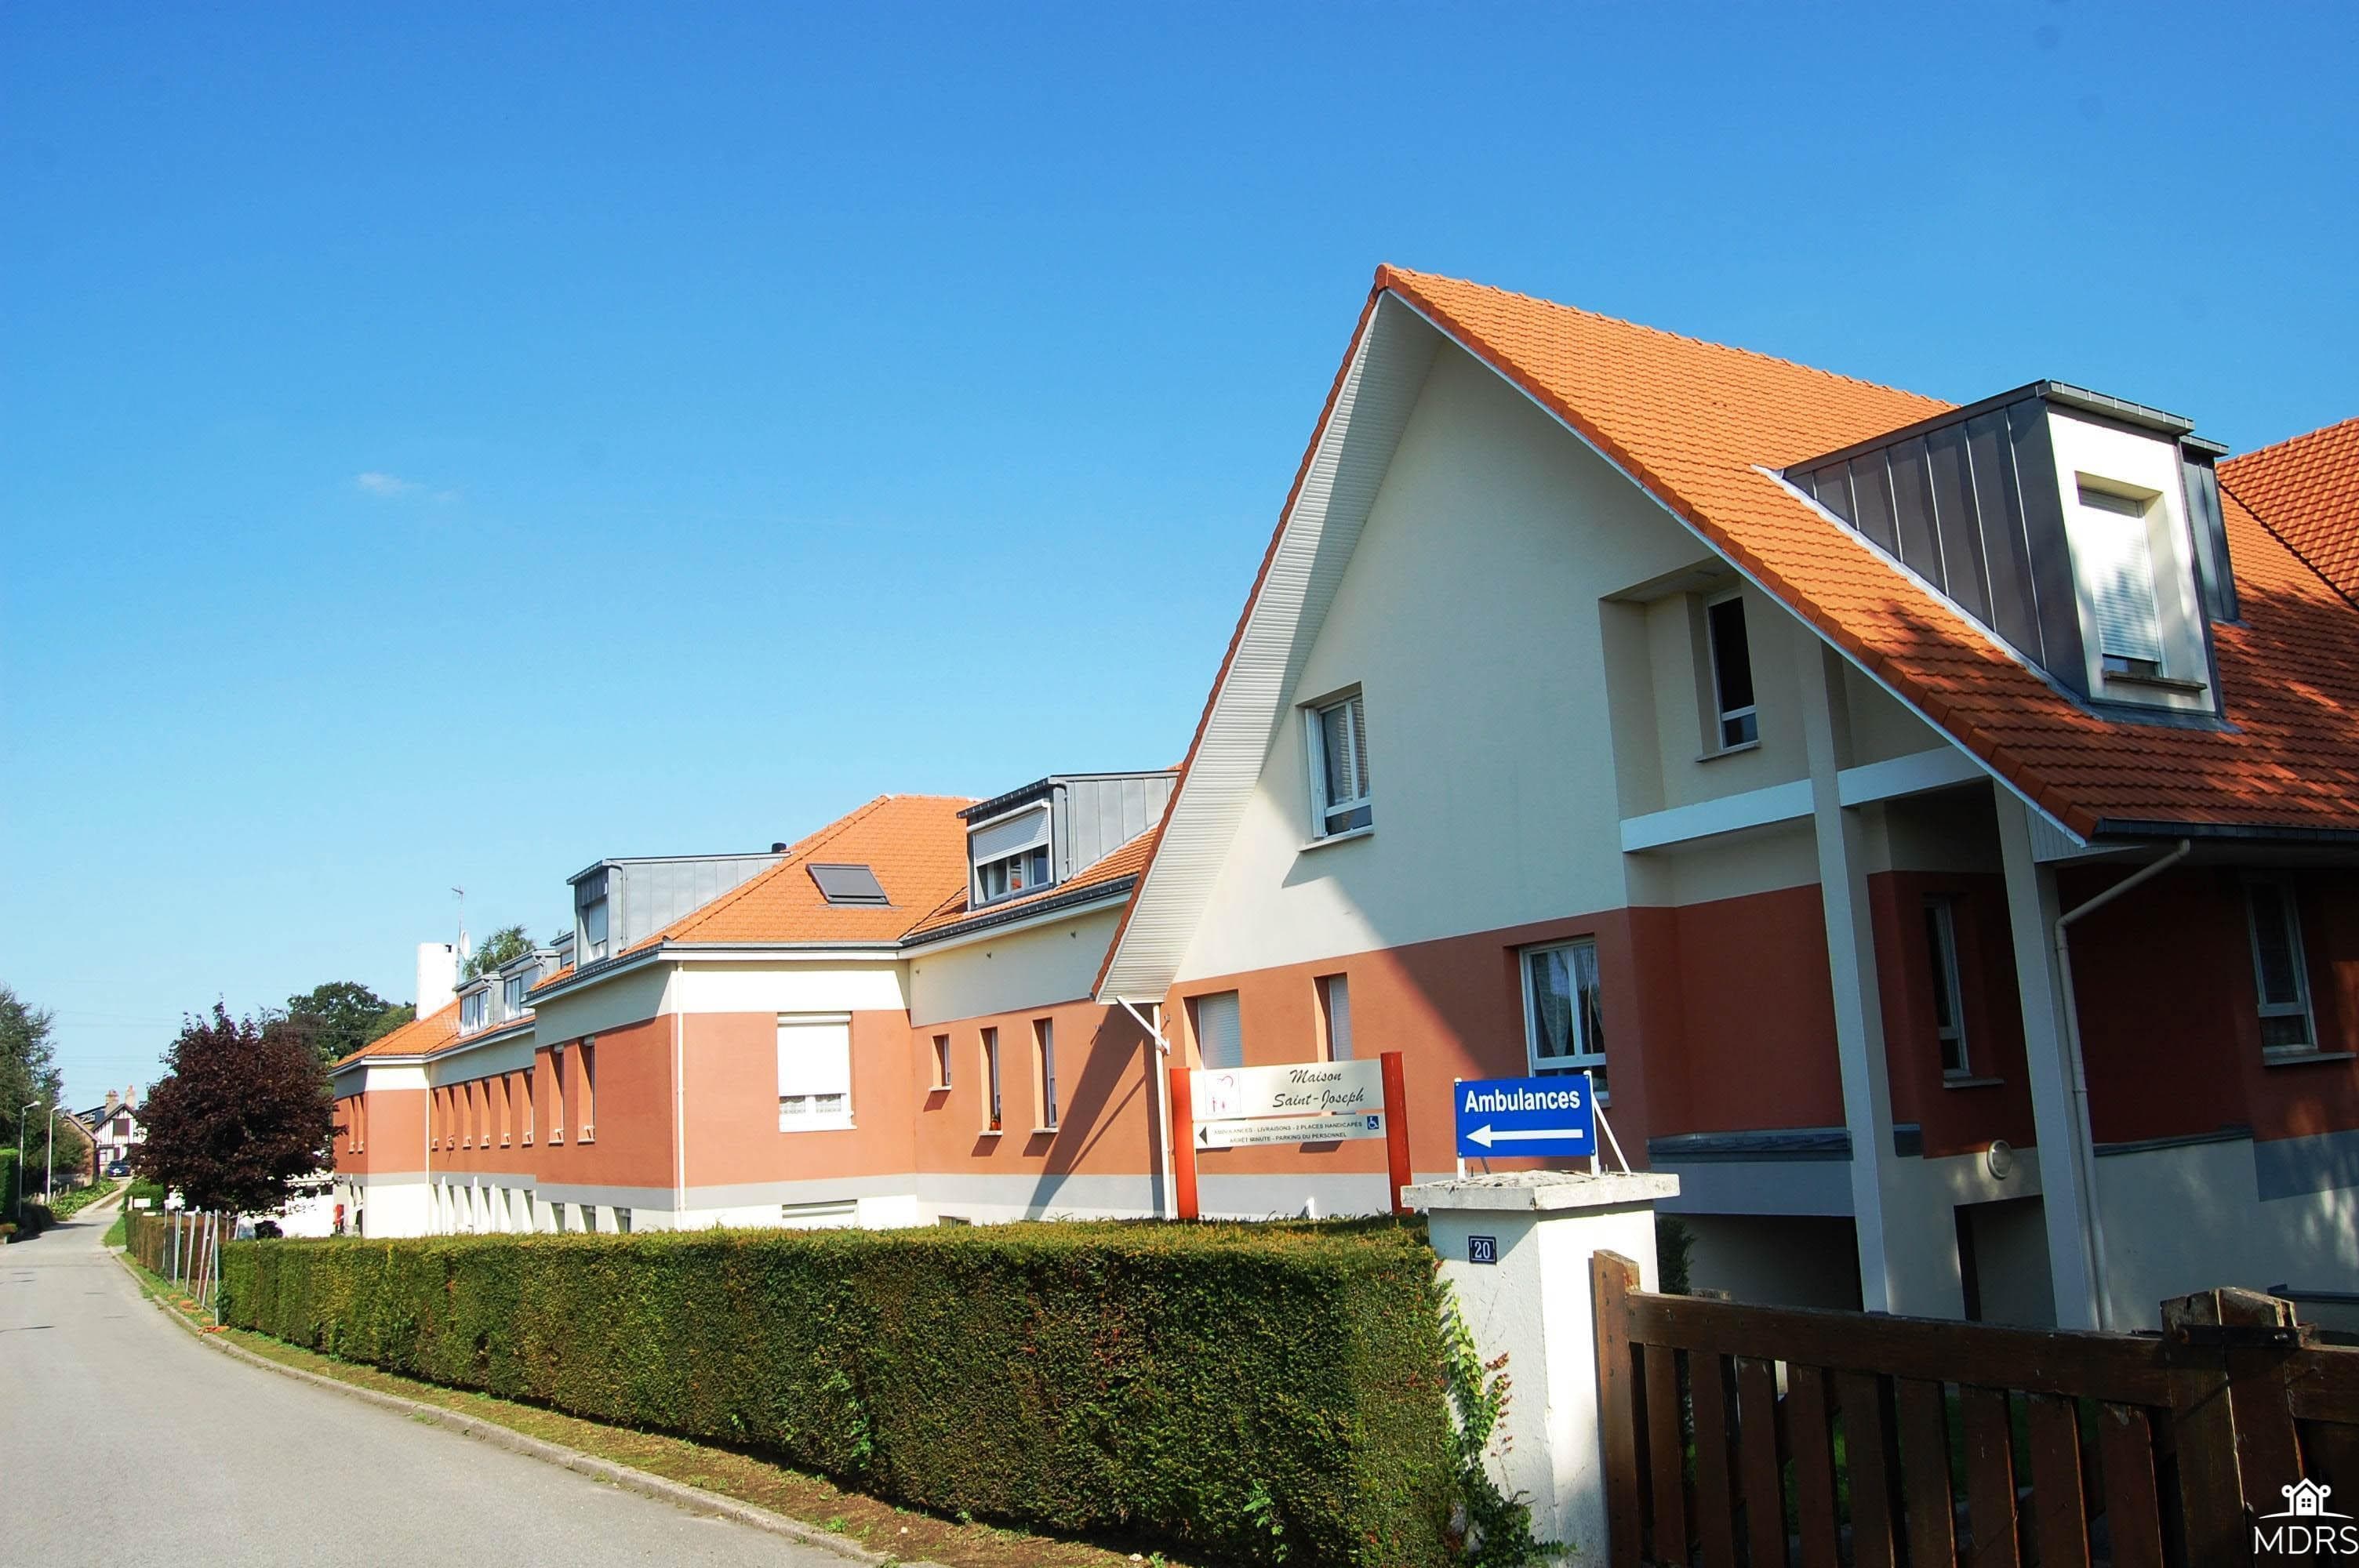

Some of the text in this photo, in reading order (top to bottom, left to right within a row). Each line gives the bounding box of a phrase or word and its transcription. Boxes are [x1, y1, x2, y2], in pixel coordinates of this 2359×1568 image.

[1289, 1069, 1342, 1083] Maison
[1272, 1087, 1364, 1109] Saint-Joseph
[1465, 1087, 1580, 1112] Ambulances
[1474, 1241, 1490, 1259] 20
